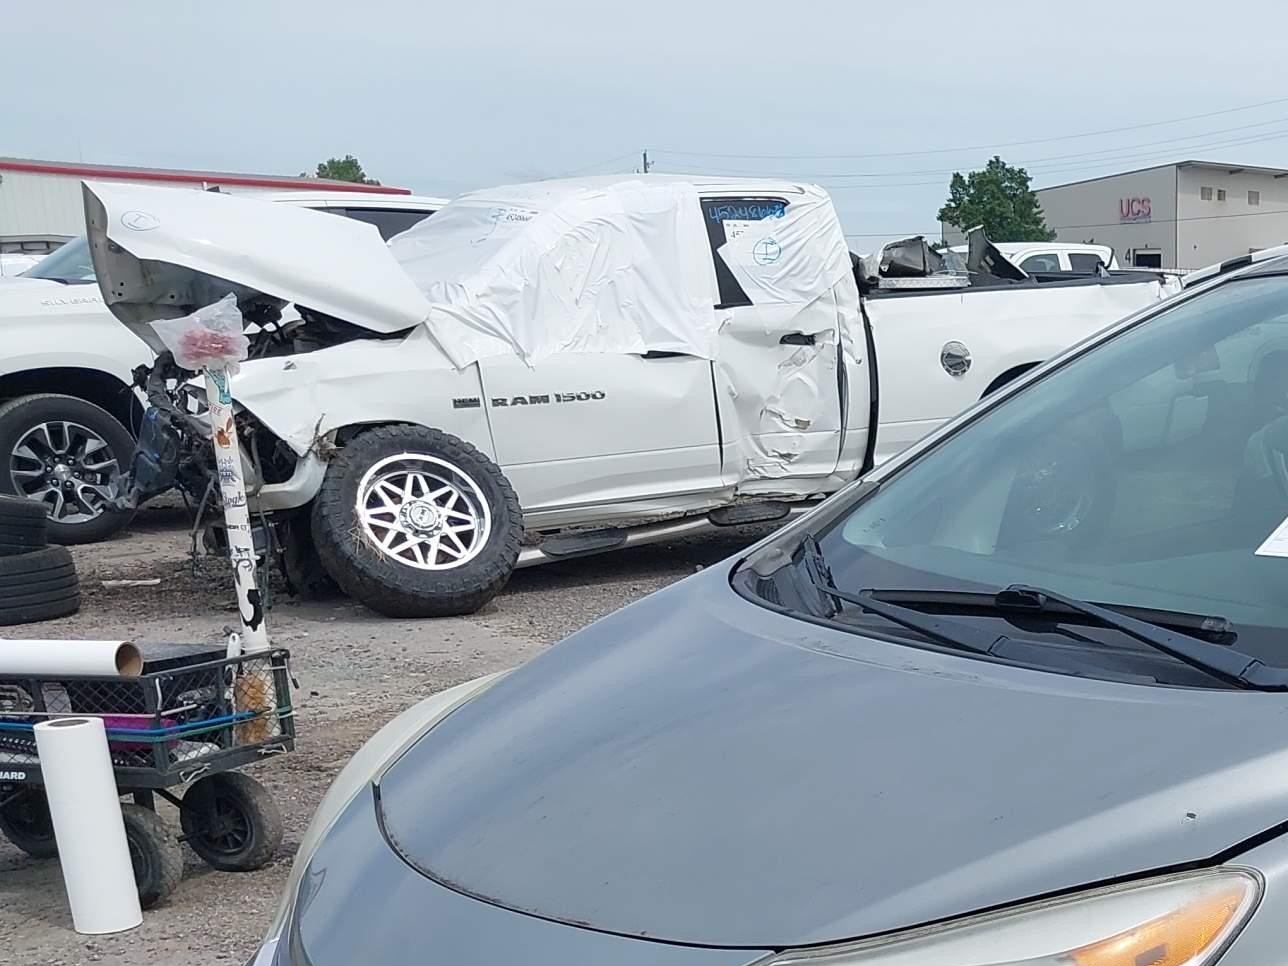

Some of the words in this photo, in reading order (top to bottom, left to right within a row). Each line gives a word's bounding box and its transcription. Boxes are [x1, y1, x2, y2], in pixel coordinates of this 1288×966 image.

[1120, 198, 1151, 218] UCS
[491, 394, 550, 407] RAM
[554, 390, 606, 403] 1500
